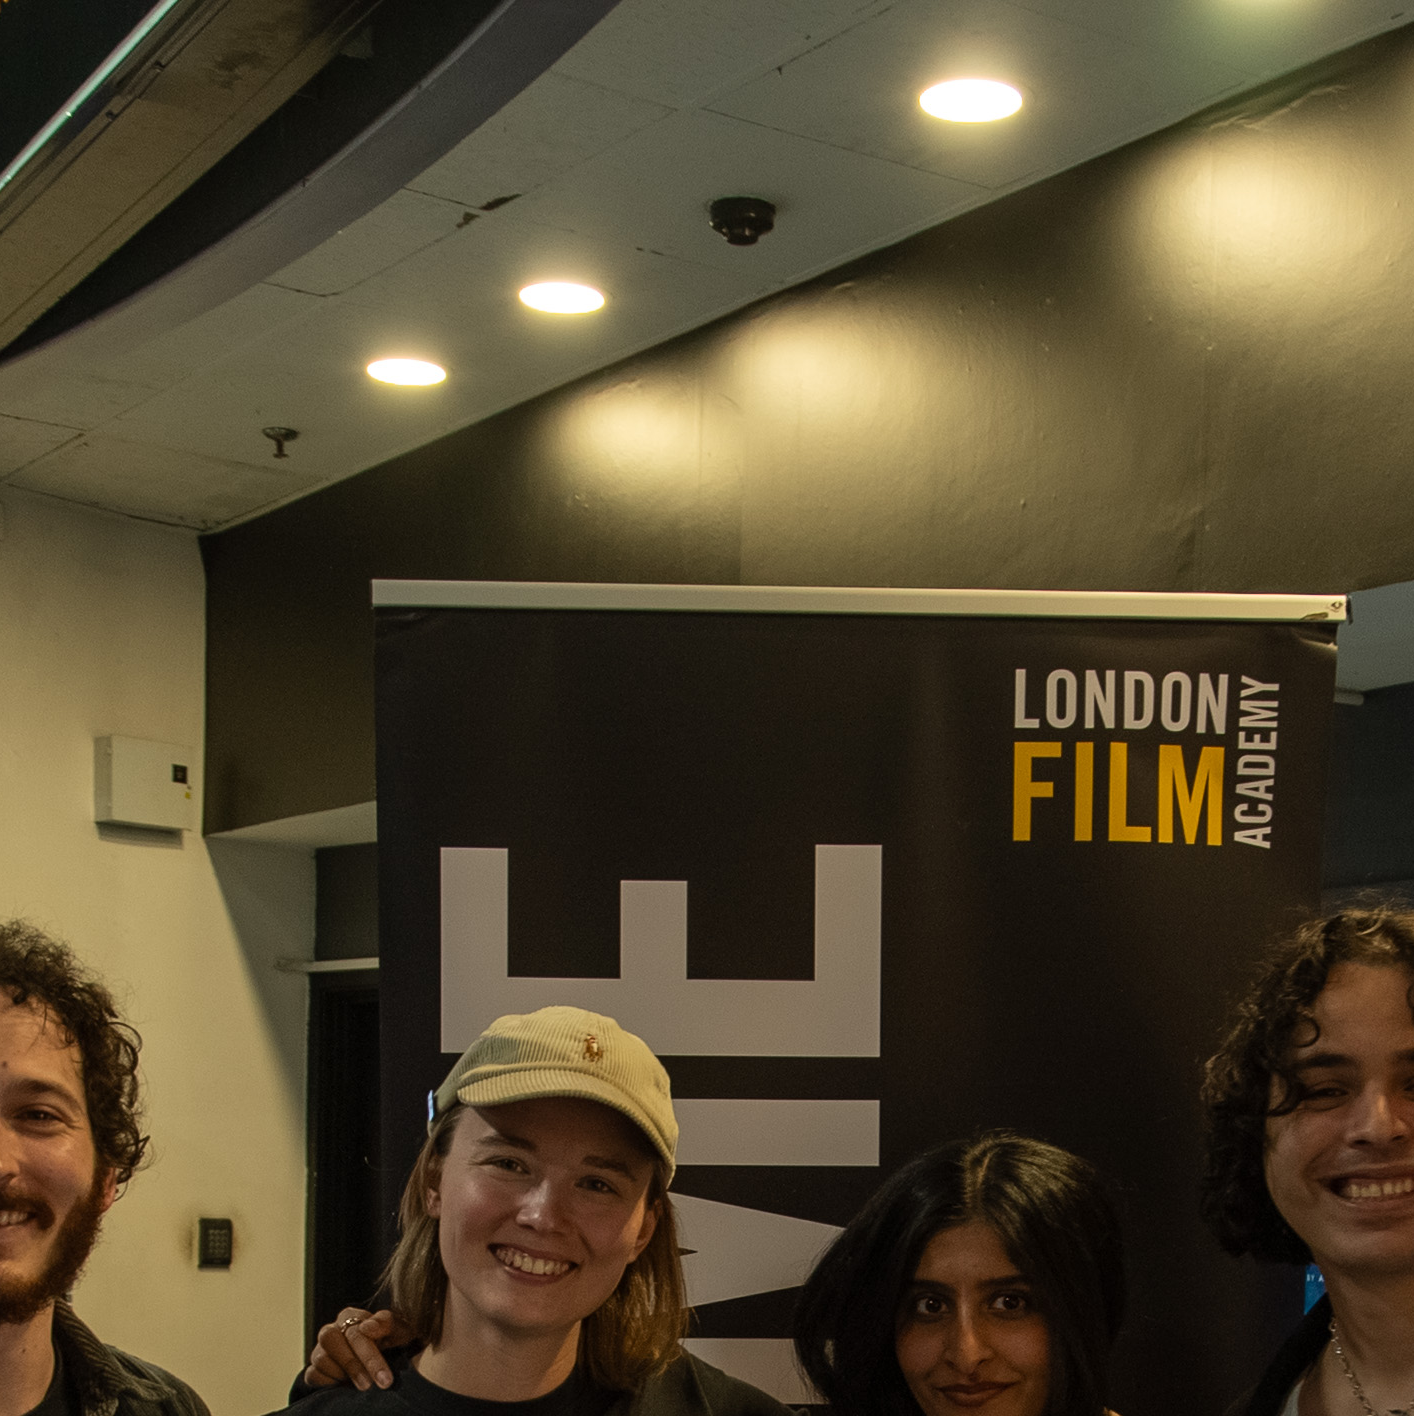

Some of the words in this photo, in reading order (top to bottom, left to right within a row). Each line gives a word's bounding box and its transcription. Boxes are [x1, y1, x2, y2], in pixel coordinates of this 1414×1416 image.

[1013, 668, 1230, 735] LONDON
[1012, 741, 1226, 846] FILM
[1233, 674, 1281, 850] ACADEMY
